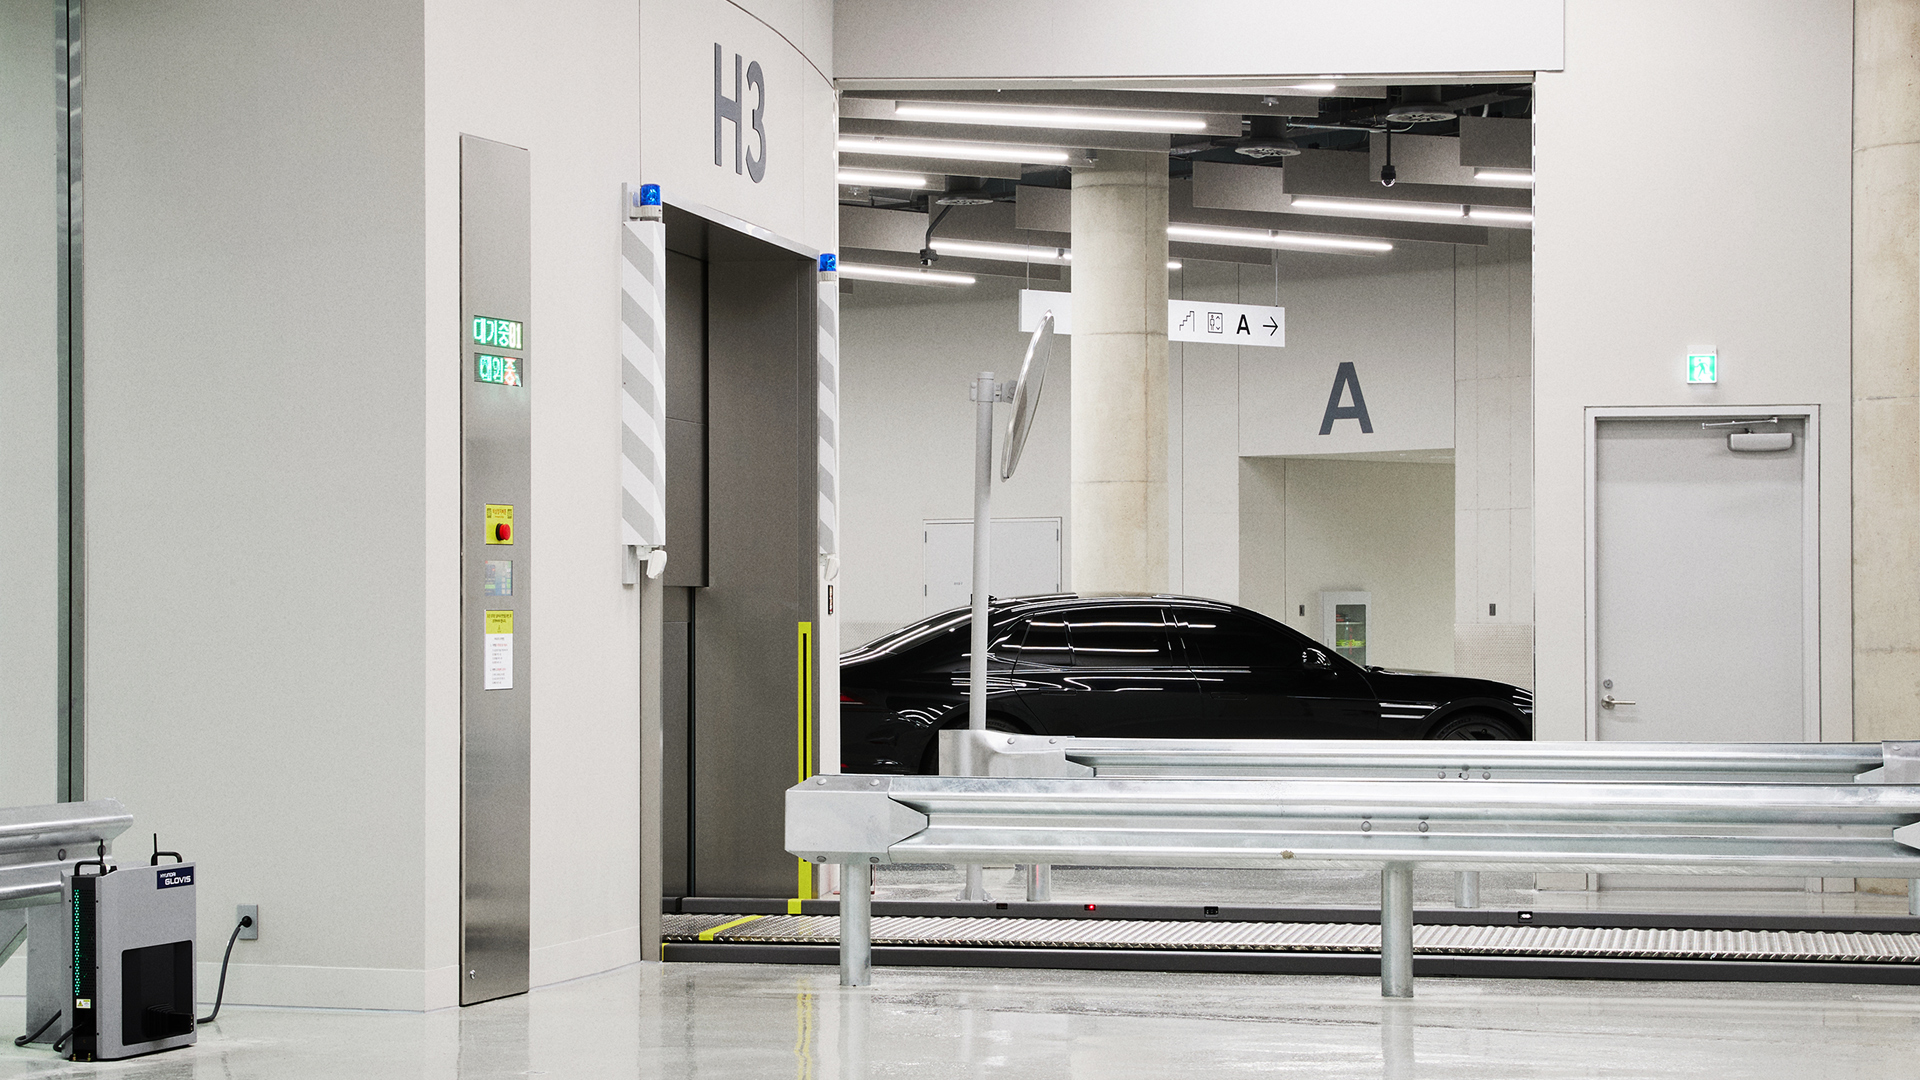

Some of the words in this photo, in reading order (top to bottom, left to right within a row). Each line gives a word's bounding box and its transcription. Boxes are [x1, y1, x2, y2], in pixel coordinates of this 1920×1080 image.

[714, 42, 767, 184] H3
[1236, 314, 1251, 336] A
[1318, 361, 1374, 435] A
[165, 876, 191, 886] GLOVIS
